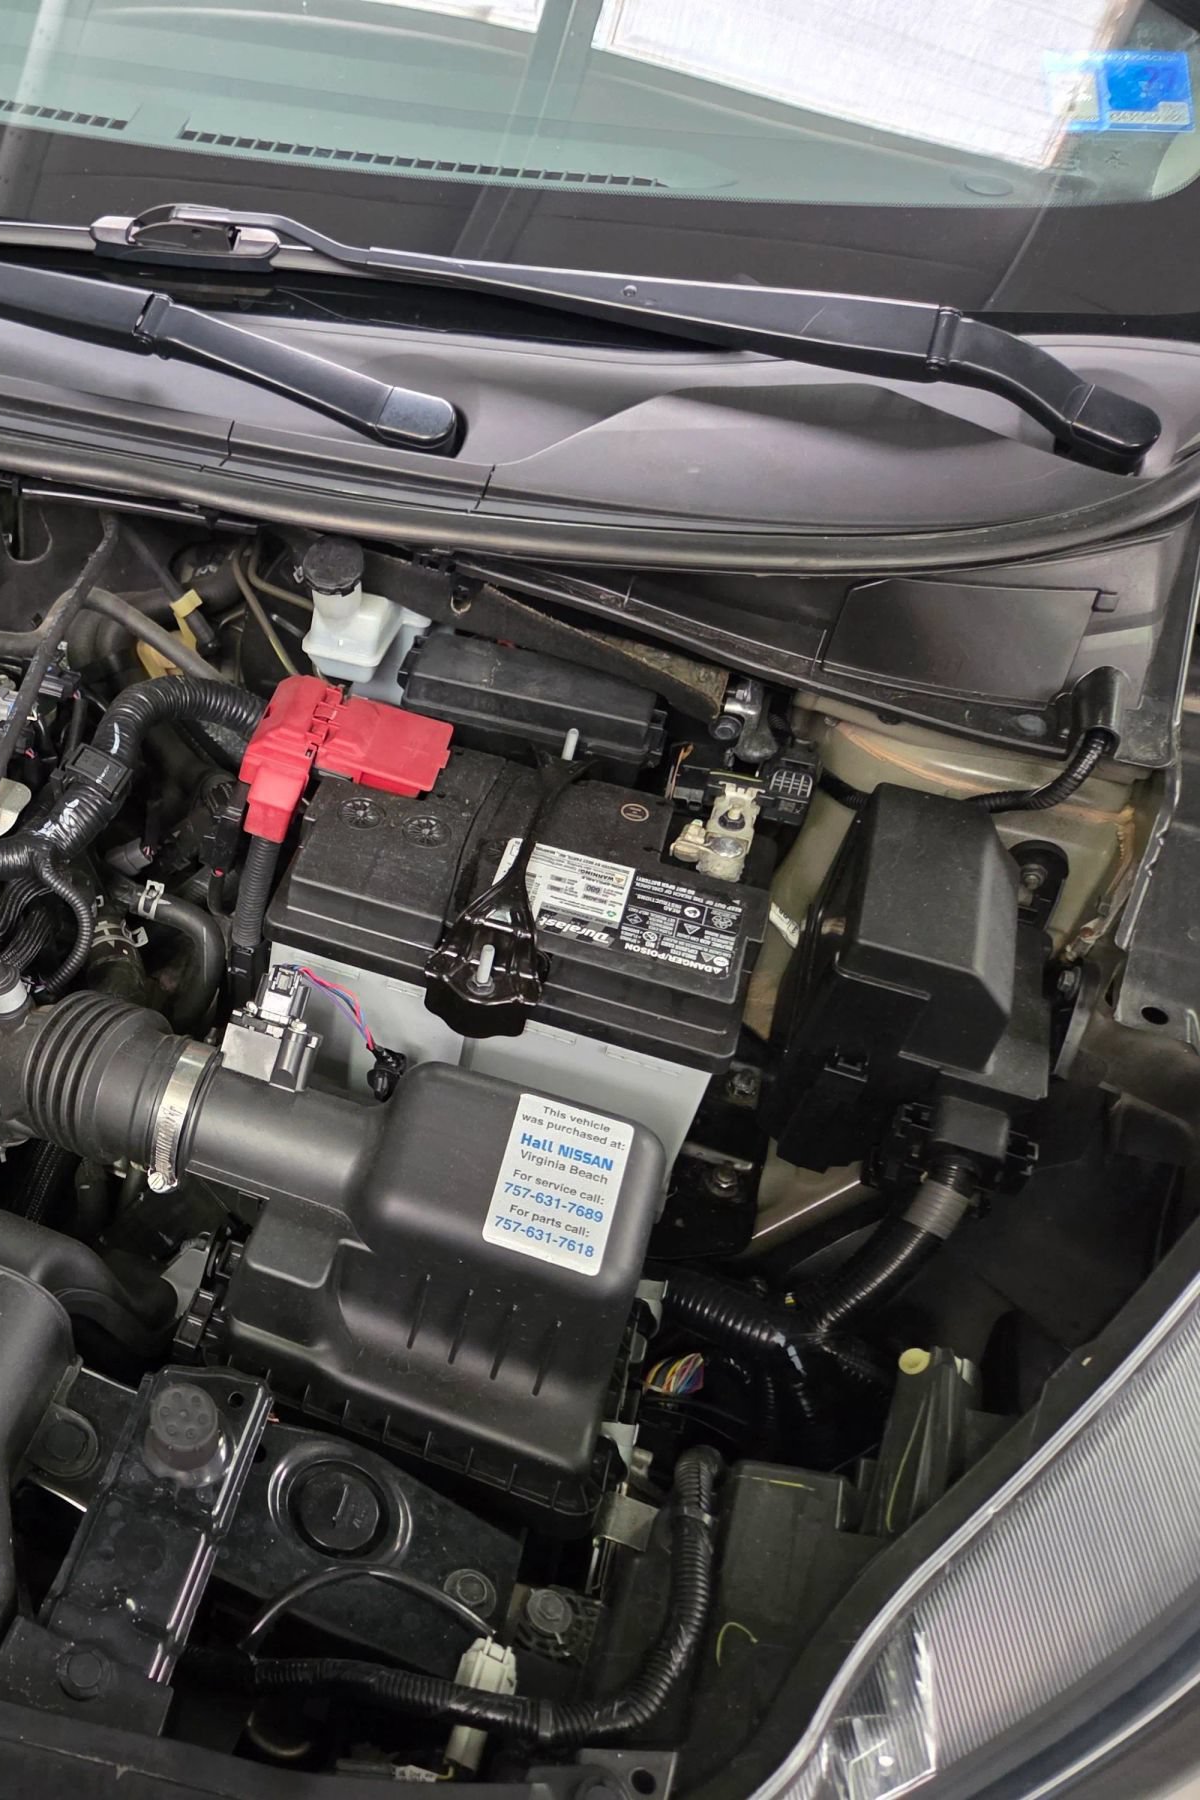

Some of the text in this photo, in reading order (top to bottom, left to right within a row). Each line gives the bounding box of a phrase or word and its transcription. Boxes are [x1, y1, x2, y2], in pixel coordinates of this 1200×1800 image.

[538, 915, 609, 943] Duralast
[624, 942, 713, 972] DANGER/POISON
[521, 1113, 626, 1151] was purchased at:
[541, 1105, 611, 1133] This vehicle
[518, 1149, 609, 1185] Virginia Beach
[519, 1132, 615, 1171] Hall NISSAN
[501, 1181, 605, 1223] 757-631-7689
[512, 1168, 605, 1205] For service call:
[491, 1215, 596, 1258] 757-631-7618
[509, 1204, 591, 1237] For parts call:
